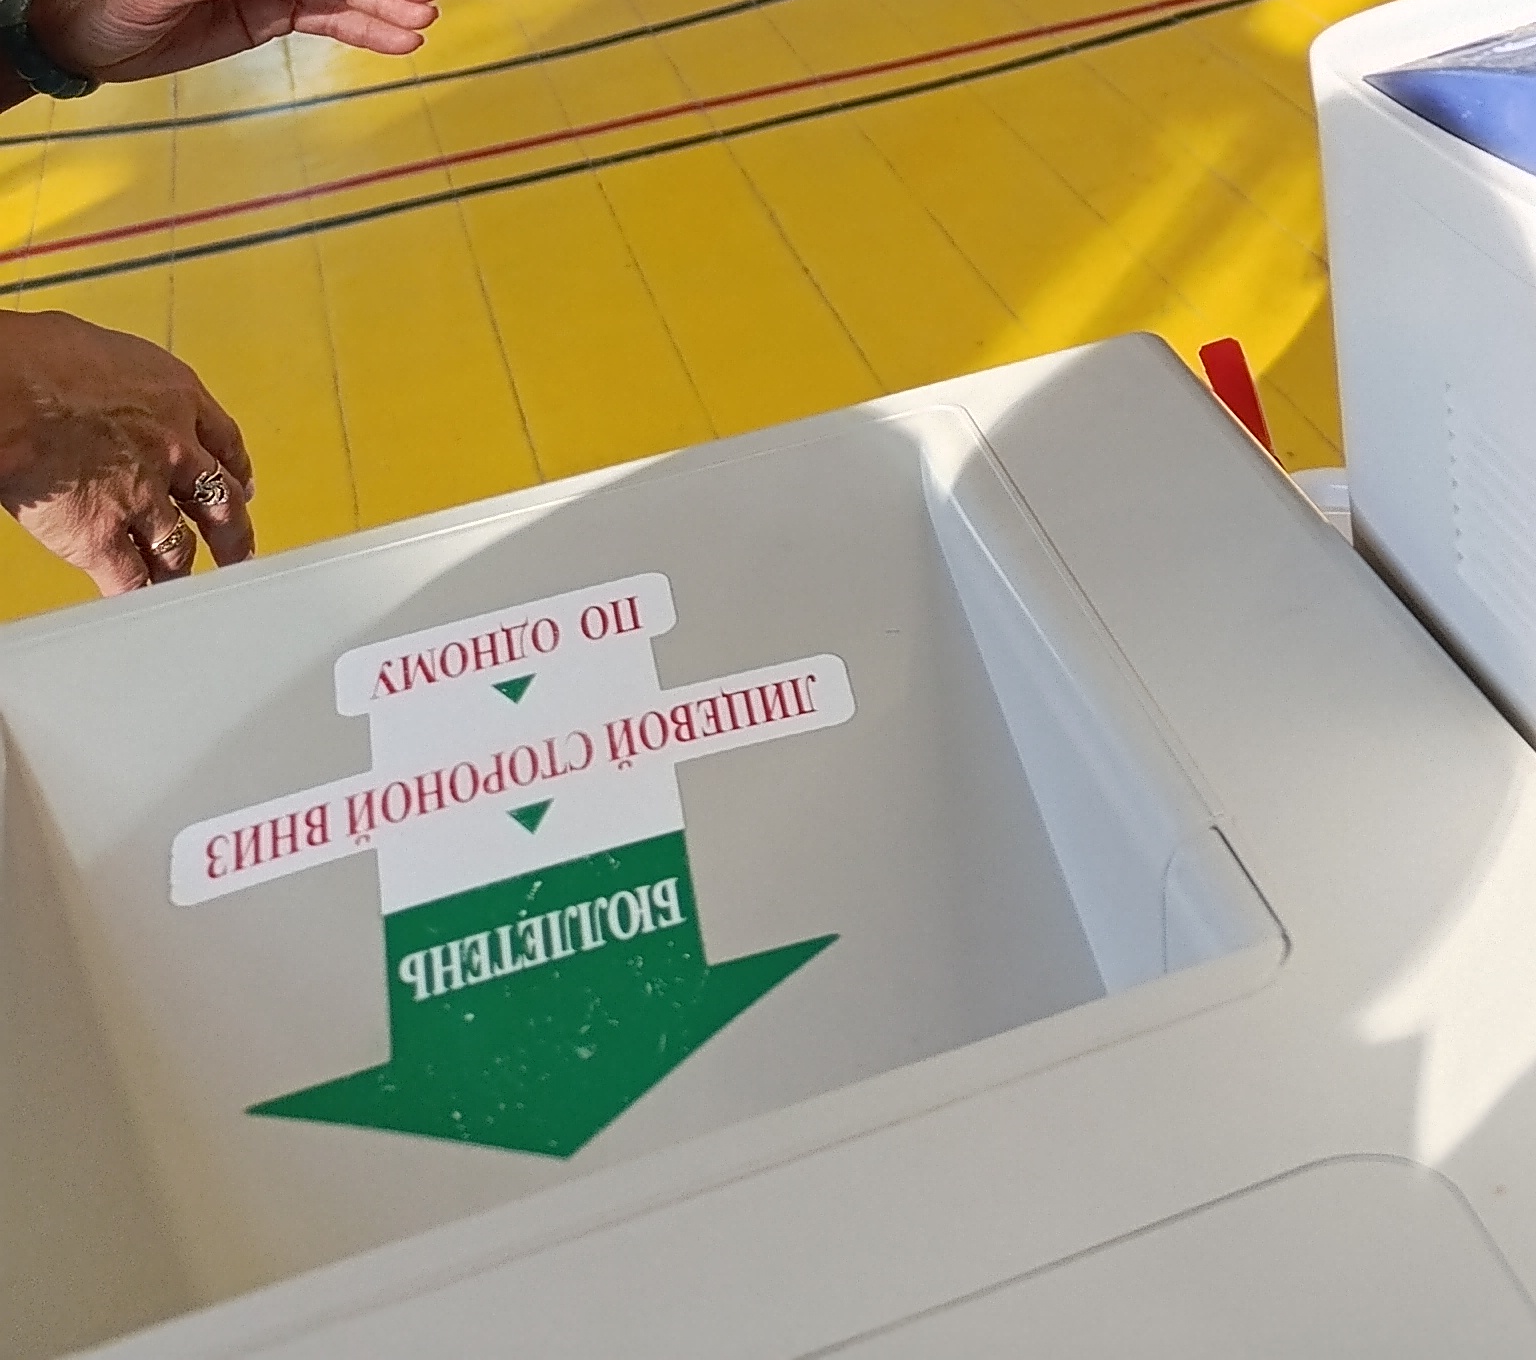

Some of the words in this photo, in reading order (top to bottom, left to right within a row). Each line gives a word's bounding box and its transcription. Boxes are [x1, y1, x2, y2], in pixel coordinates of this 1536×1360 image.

[370, 616, 560, 700] ОДНОМУ
[581, 595, 644, 640] ПО
[606, 672, 818, 769] ЛИЦЕВОЙ
[347, 730, 594, 845] СТОРОНОЙ
[206, 800, 332, 880] ВНИЗ
[397, 877, 688, 1001] БЮЛЛЕТЕНЬ
